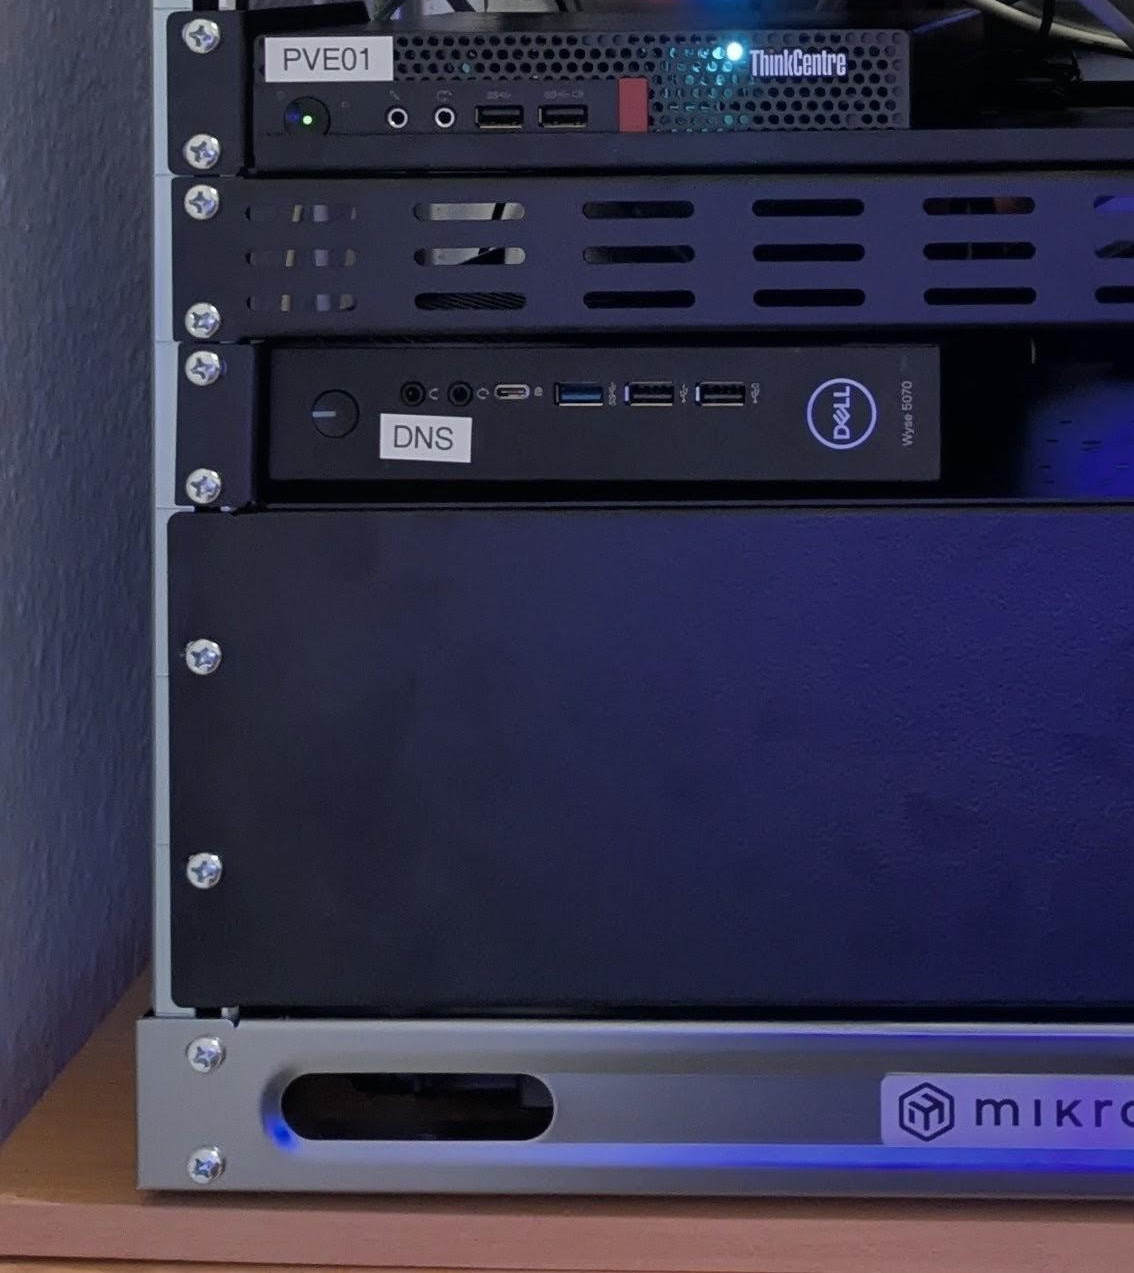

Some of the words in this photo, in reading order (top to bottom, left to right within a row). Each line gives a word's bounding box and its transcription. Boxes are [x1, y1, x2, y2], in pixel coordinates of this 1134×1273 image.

[283, 47, 369, 71] PVE01
[749, 48, 847, 76] ThinkCentre
[901, 380, 913, 411] 5070
[833, 385, 850, 439] DELL
[393, 424, 454, 450] DNS
[901, 414, 915, 446] Wyse
